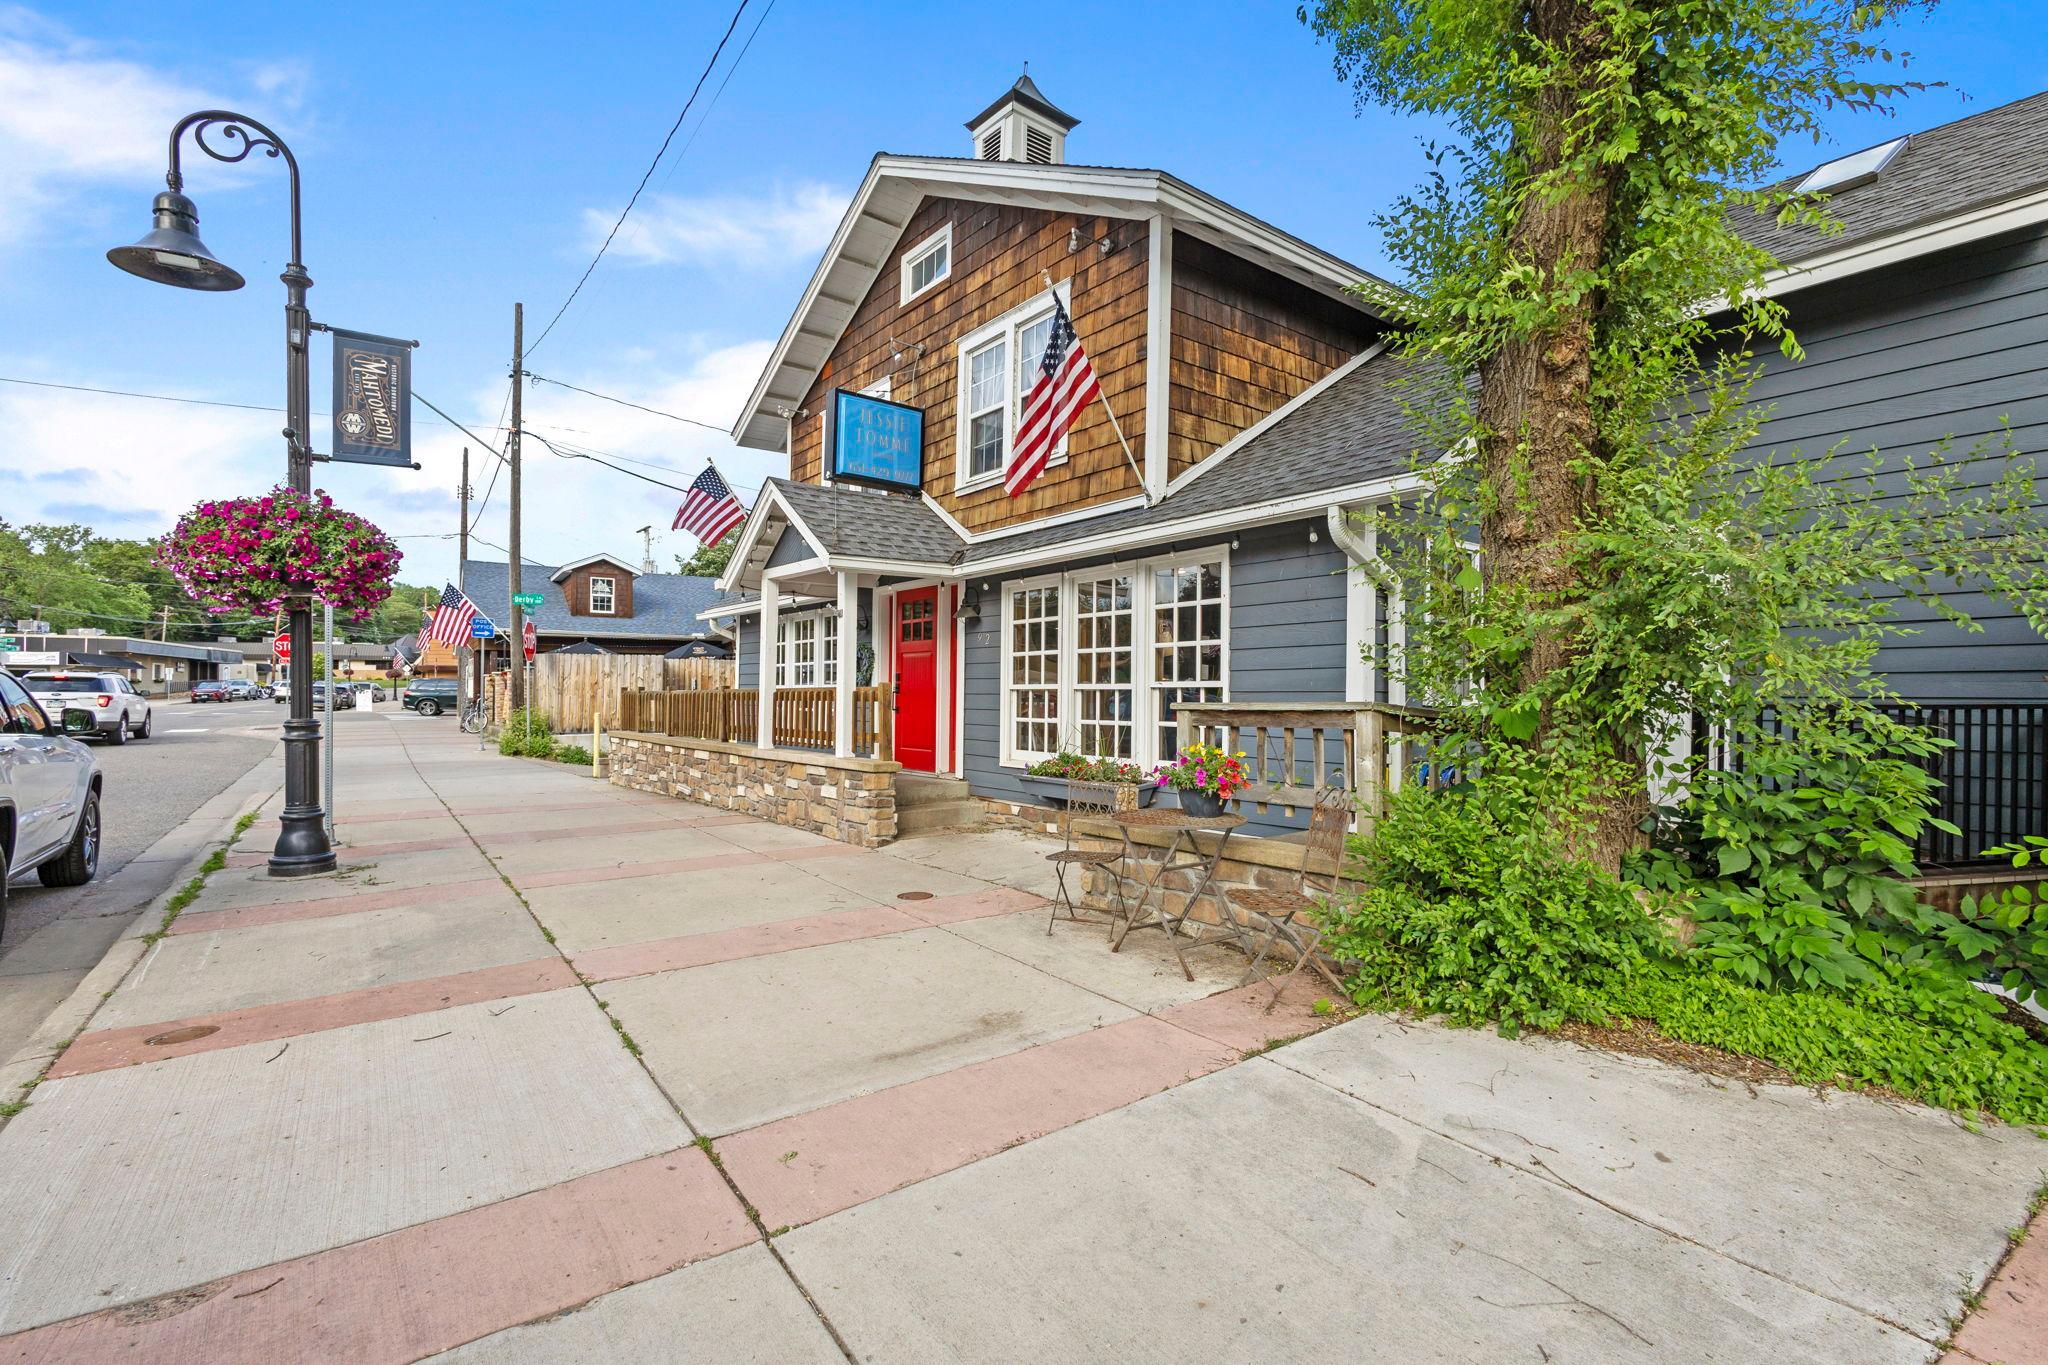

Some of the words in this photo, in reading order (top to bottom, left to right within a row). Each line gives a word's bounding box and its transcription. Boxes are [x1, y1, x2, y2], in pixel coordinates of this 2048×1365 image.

[353, 357, 395, 439] MAHTOMEDI
[514, 595, 534, 604] Derby
[275, 641, 291, 651] ST
